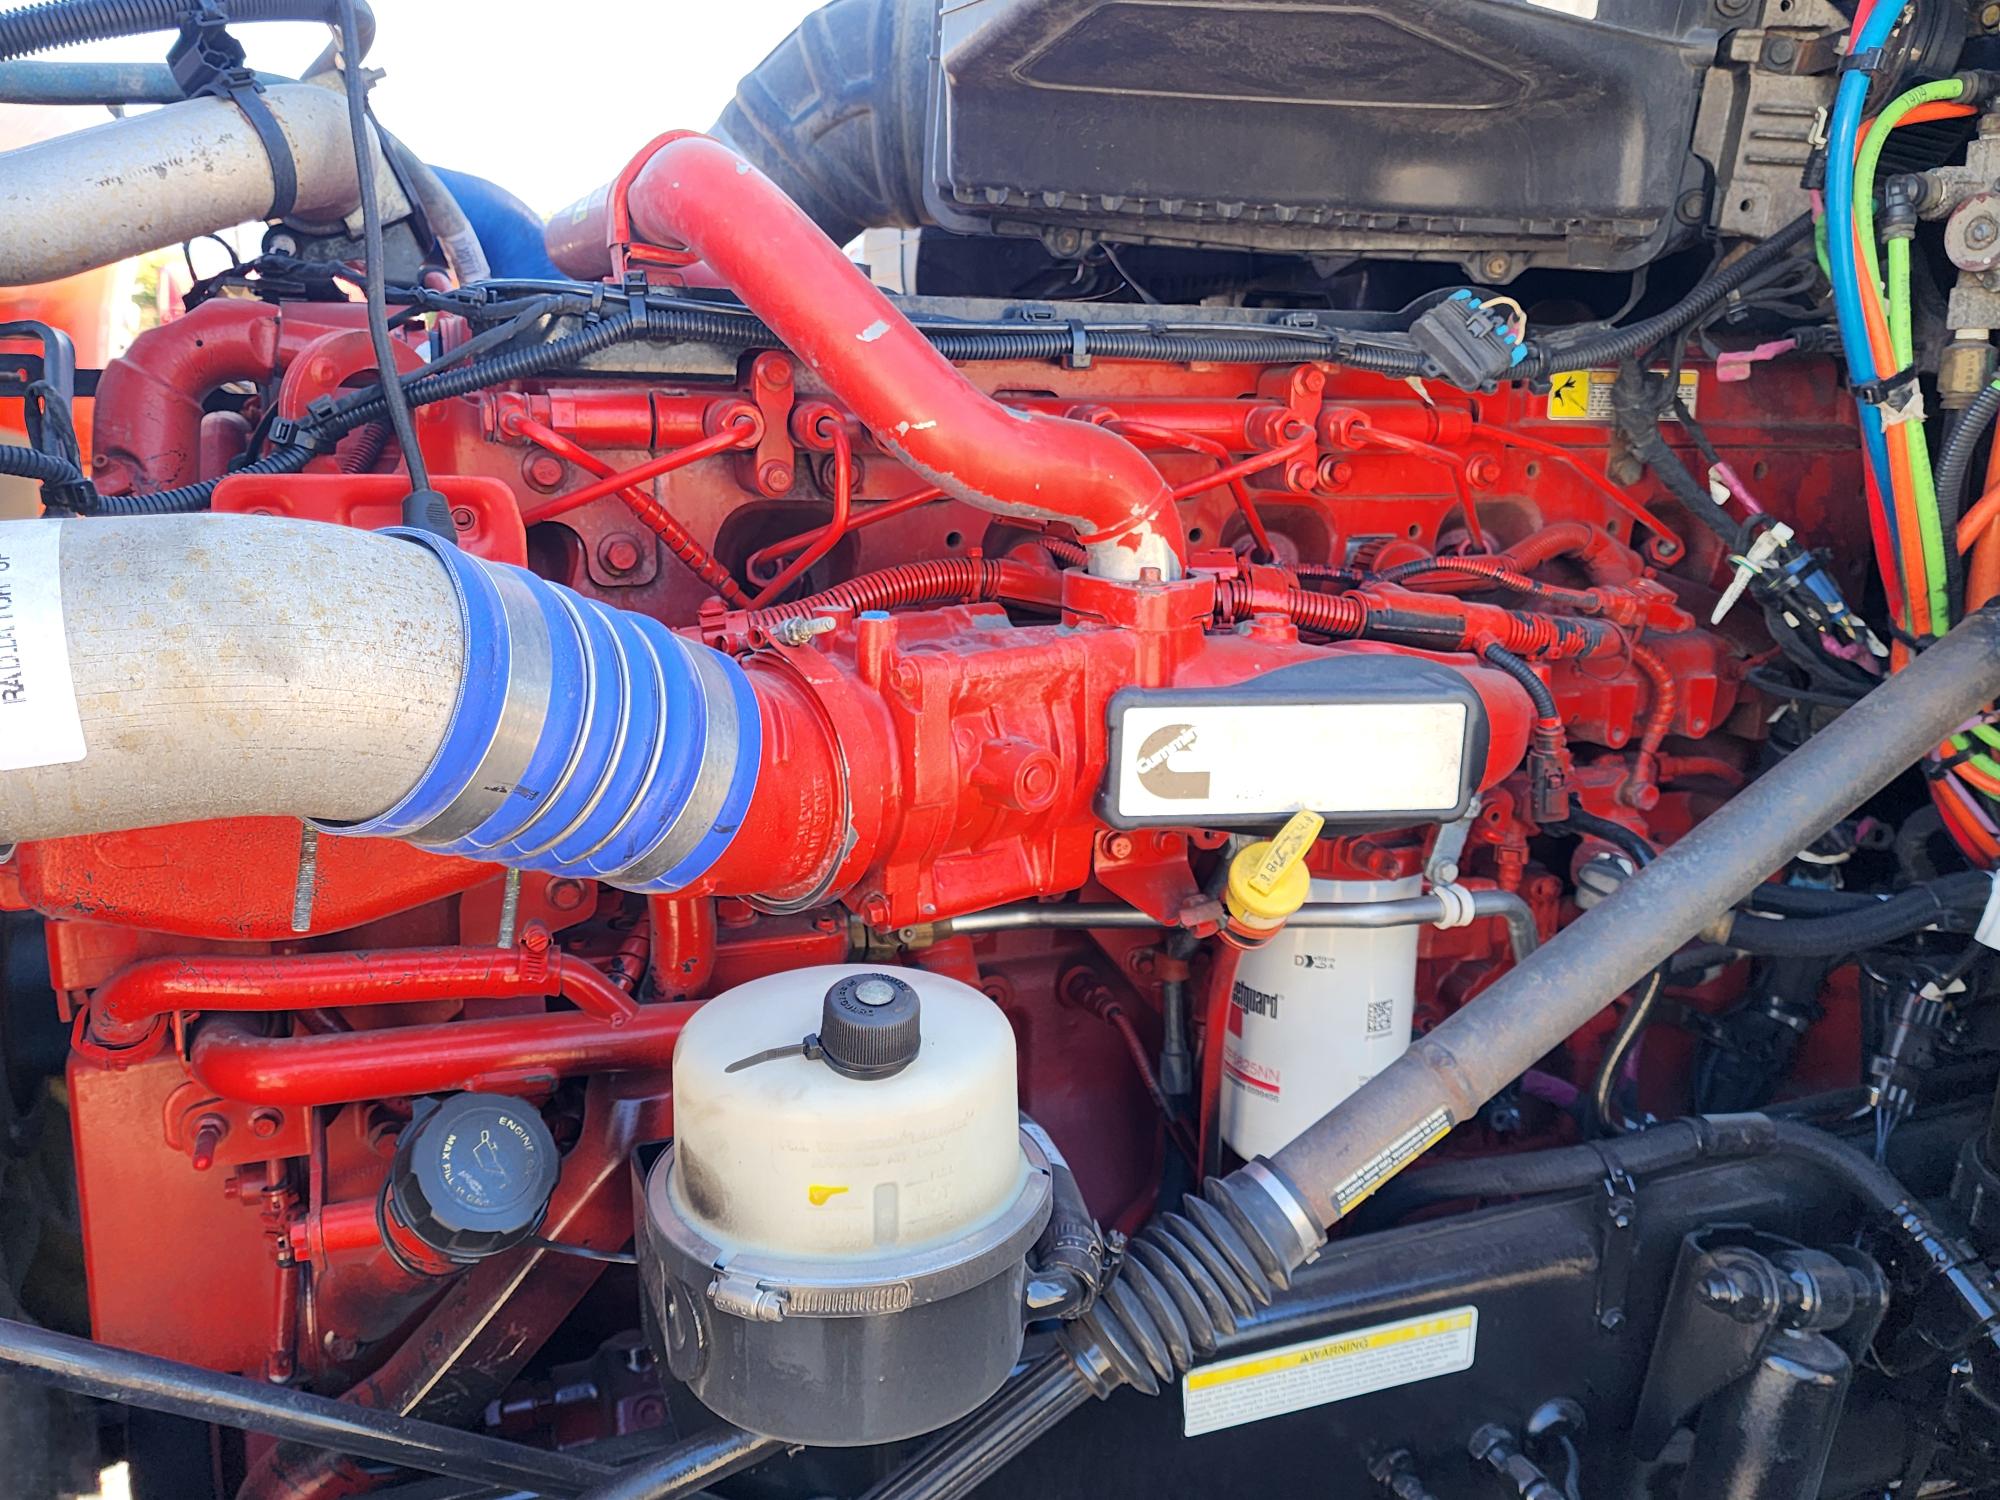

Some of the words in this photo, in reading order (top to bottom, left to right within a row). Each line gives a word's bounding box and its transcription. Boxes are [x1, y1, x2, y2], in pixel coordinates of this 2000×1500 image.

[1137, 728, 1198, 775] Cummin
[442, 1134, 457, 1161] MAX
[442, 1163, 455, 1186] FILL
[1308, 1337, 1370, 1360] WARNING
